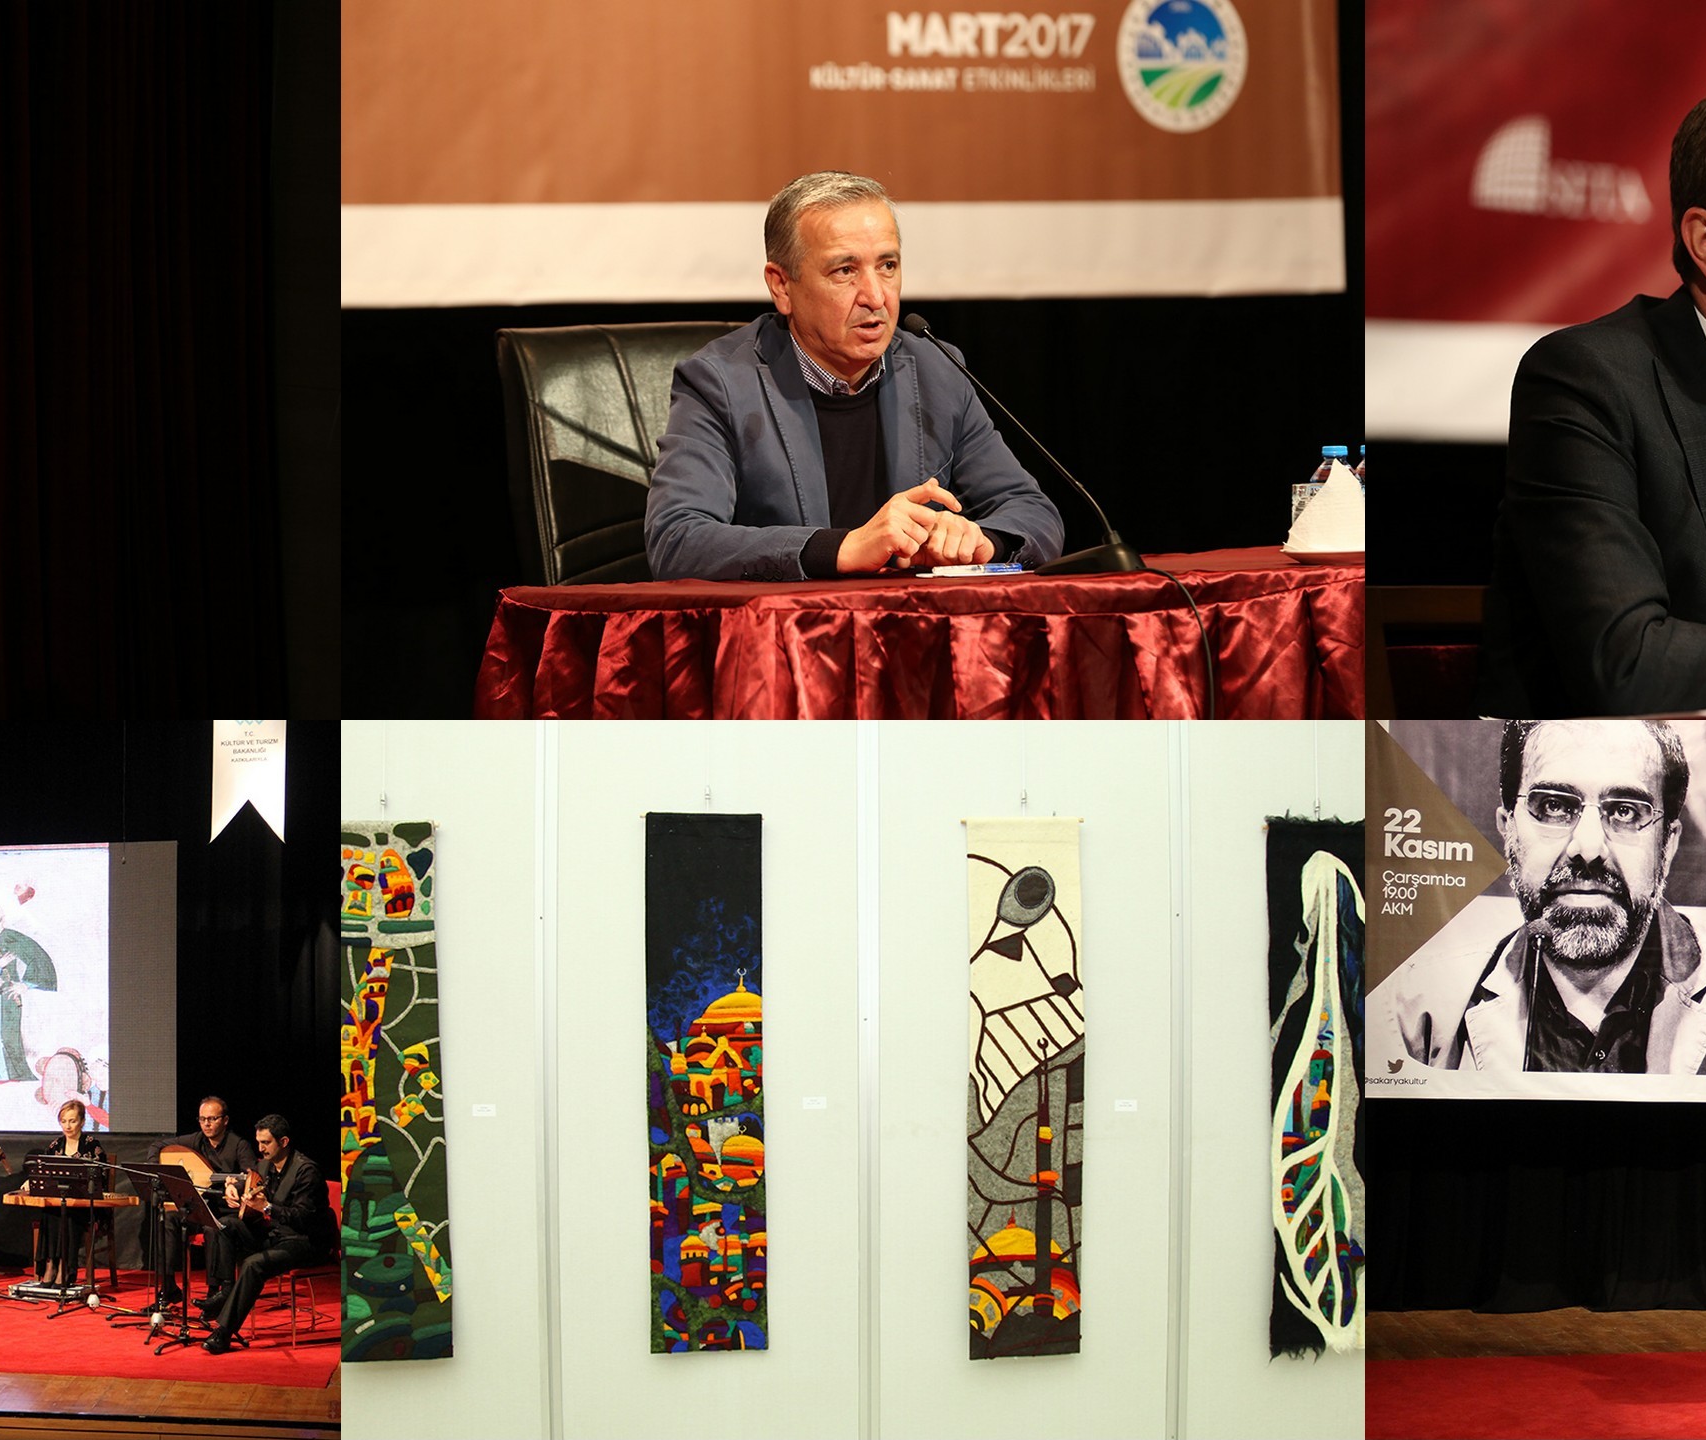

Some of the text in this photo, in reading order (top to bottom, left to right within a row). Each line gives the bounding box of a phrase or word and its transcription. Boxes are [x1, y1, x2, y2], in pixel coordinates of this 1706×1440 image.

[887, 12, 1095, 58] MART2017
[1383, 807, 1422, 834] 22
[1384, 833, 1474, 862] Kasım
[1382, 870, 1466, 888] Çarşamba
[1382, 886, 1417, 900] 19.00
[1381, 902, 1413, 915] AKM
